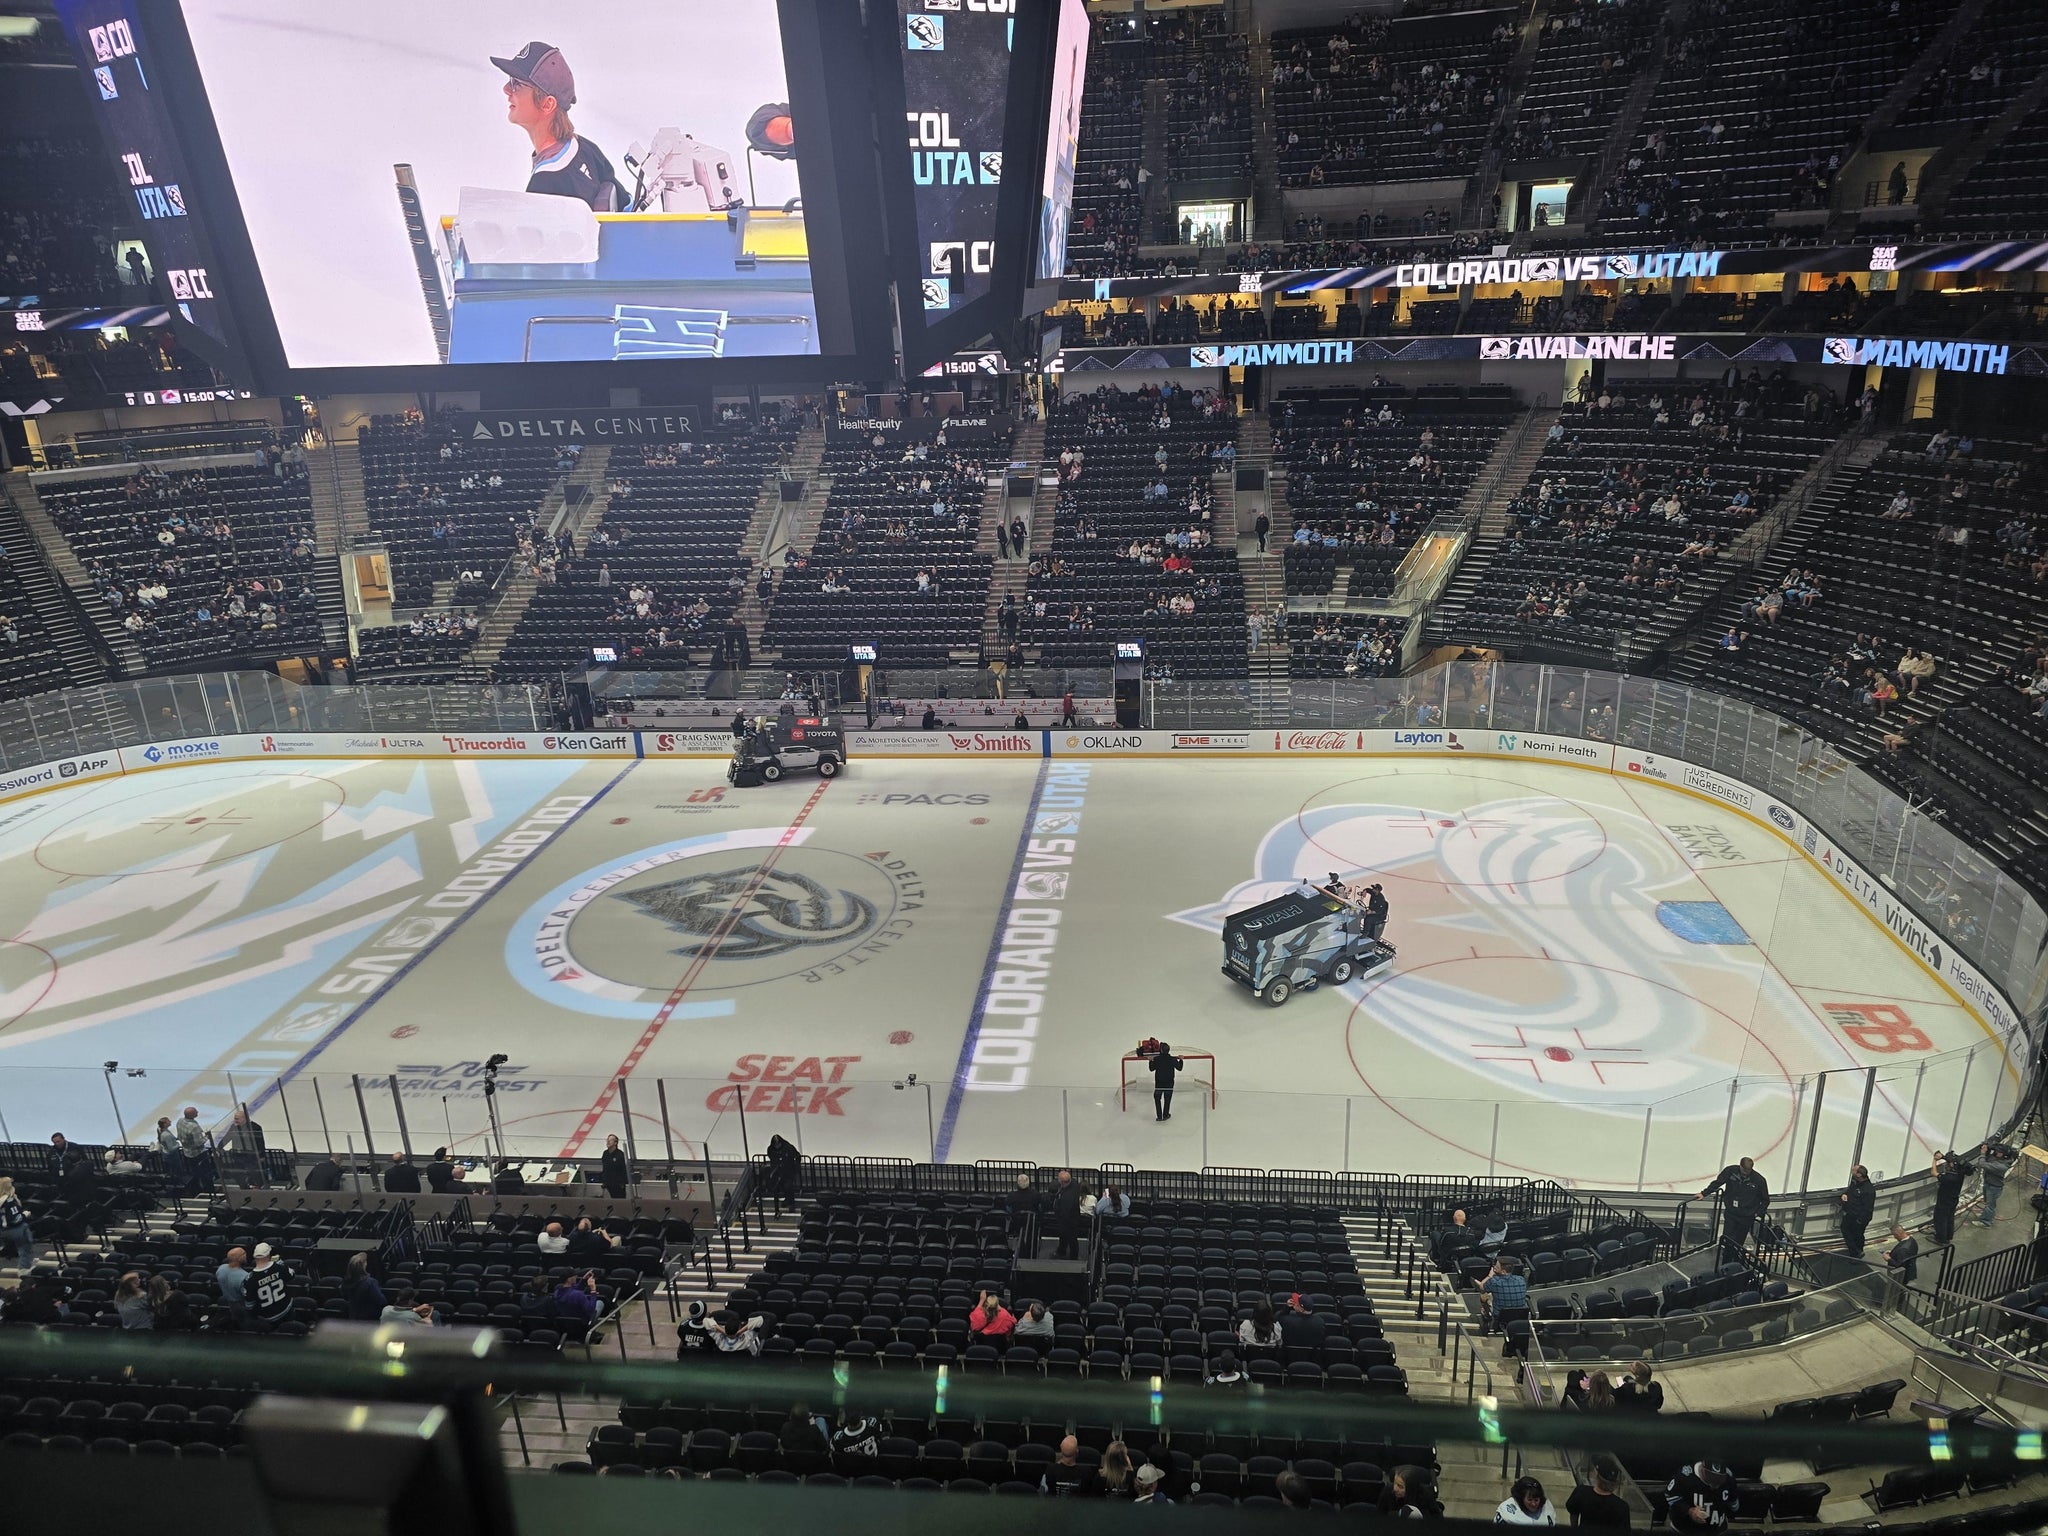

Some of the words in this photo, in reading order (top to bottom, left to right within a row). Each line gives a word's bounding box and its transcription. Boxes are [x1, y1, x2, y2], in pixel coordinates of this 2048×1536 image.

[913, 152, 974, 185] UTA
[135, 187, 173, 220] UTA
[1872, 246, 1897, 259] SEAT
[1563, 257, 1599, 281] VS
[1644, 252, 1720, 278] UTAH
[1869, 259, 1896, 270] GEEK
[1239, 283, 1262, 293] GEEK
[1240, 274, 1261, 284] SEAT
[15, 312, 41, 322] SEAT
[16, 321, 45, 331] GEEK
[1224, 341, 1353, 366] MAMMOTH
[1516, 336, 1677, 360] AVALANCHE
[1861, 338, 2009, 375] MAMMOTH
[945, 361, 977, 374] 15:00
[144, 392, 155, 405] 0
[183, 391, 215, 403] 15:00
[498, 419, 585, 437] DELTA
[594, 416, 692, 435] CENTER
[838, 419, 903, 431] HealthEquity
[950, 418, 987, 428] FILEVINE
[855, 652, 868, 660] UTA
[1119, 650, 1132, 658] UTA
[389, 739, 424, 748] ULTRA
[455, 737, 526, 751] Trucordia
[558, 736, 587, 750] Ken
[589, 736, 627, 750] Garff
[974, 733, 1031, 751] Smith's
[1084, 736, 1142, 748] OKLAND
[1288, 731, 1349, 750] Coca-Cola
[1395, 731, 1442, 746] Layton
[168, 742, 219, 755] moxie
[1523, 740, 1555, 752] Nomi
[1558, 744, 1597, 758] Health
[1642, 765, 1667, 780] YouTube
[1688, 767, 1710, 779] JUST
[1041, 762, 1092, 809] UTAH
[1688, 776, 1749, 806] INGREDIENTS
[881, 793, 991, 806] PACS
[1773, 808, 1792, 828] Ford
[1665, 825, 1718, 860] BANK
[1693, 825, 1747, 861] ZIONS
[424, 795, 597, 910] COLORADO
[1022, 838, 1077, 868] VS
[884, 859, 927, 913] DELTA
[1836, 858, 1879, 908] DELTA
[535, 907, 576, 968] DELTA
[569, 849, 685, 903] CENTER
[1244, 904, 1304, 931] UTAH
[798, 917, 914, 985] CENTER
[1231, 949, 1251, 967] UTAH
[318, 953, 414, 995] VS
[967, 908, 1063, 1093] COLORADO
[727, 1054, 862, 1083] SEAT
[345, 1078, 463, 1092] AMERICA
[705, 1085, 855, 1116] GEEK
[258, 1272, 280, 1287] COOLEY
[257, 1278, 286, 1308] 92
[1722, 1489, 1729, 1501] C
